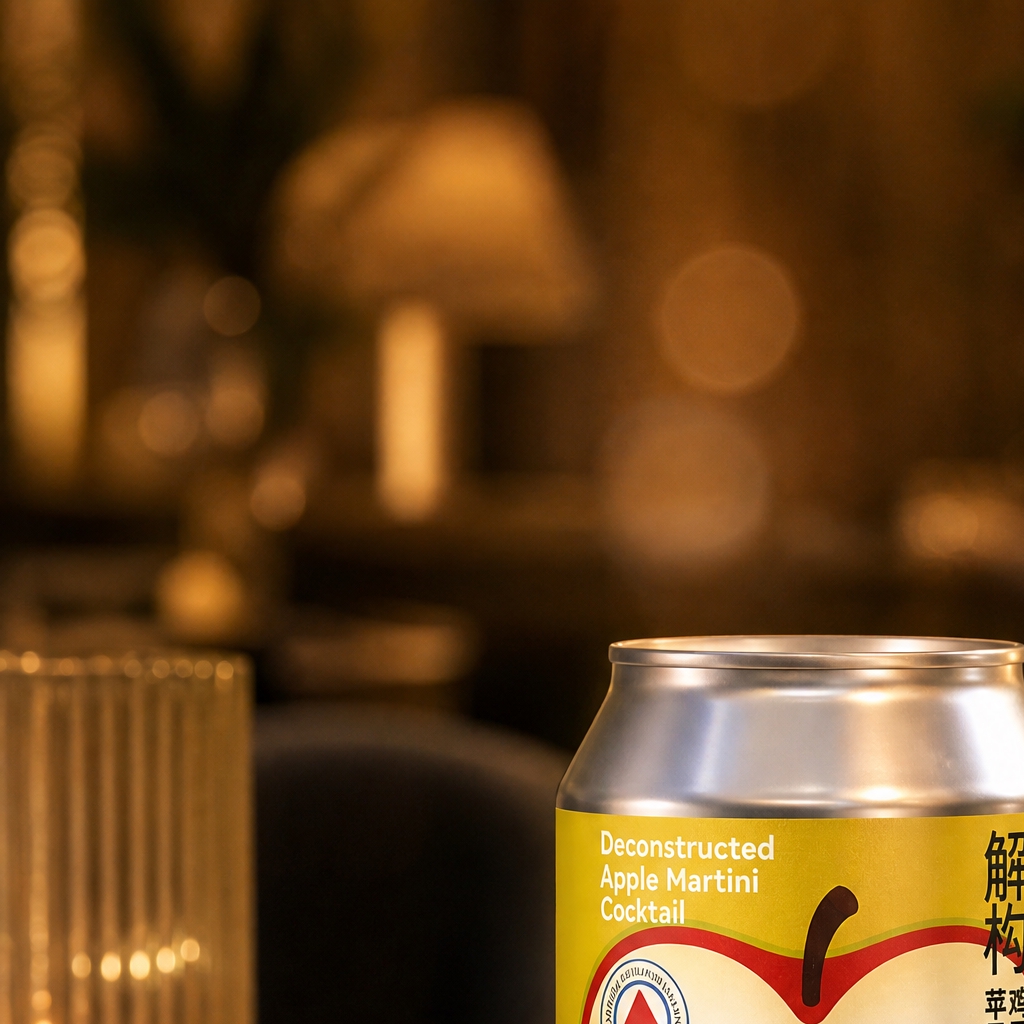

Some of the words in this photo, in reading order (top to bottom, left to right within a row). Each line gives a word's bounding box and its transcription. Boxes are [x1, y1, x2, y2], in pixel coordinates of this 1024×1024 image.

[600, 830, 775, 861] Deconstructed
[600, 864, 659, 896] Apple
[666, 867, 759, 893] Martini
[600, 896, 685, 924] Cocktail
